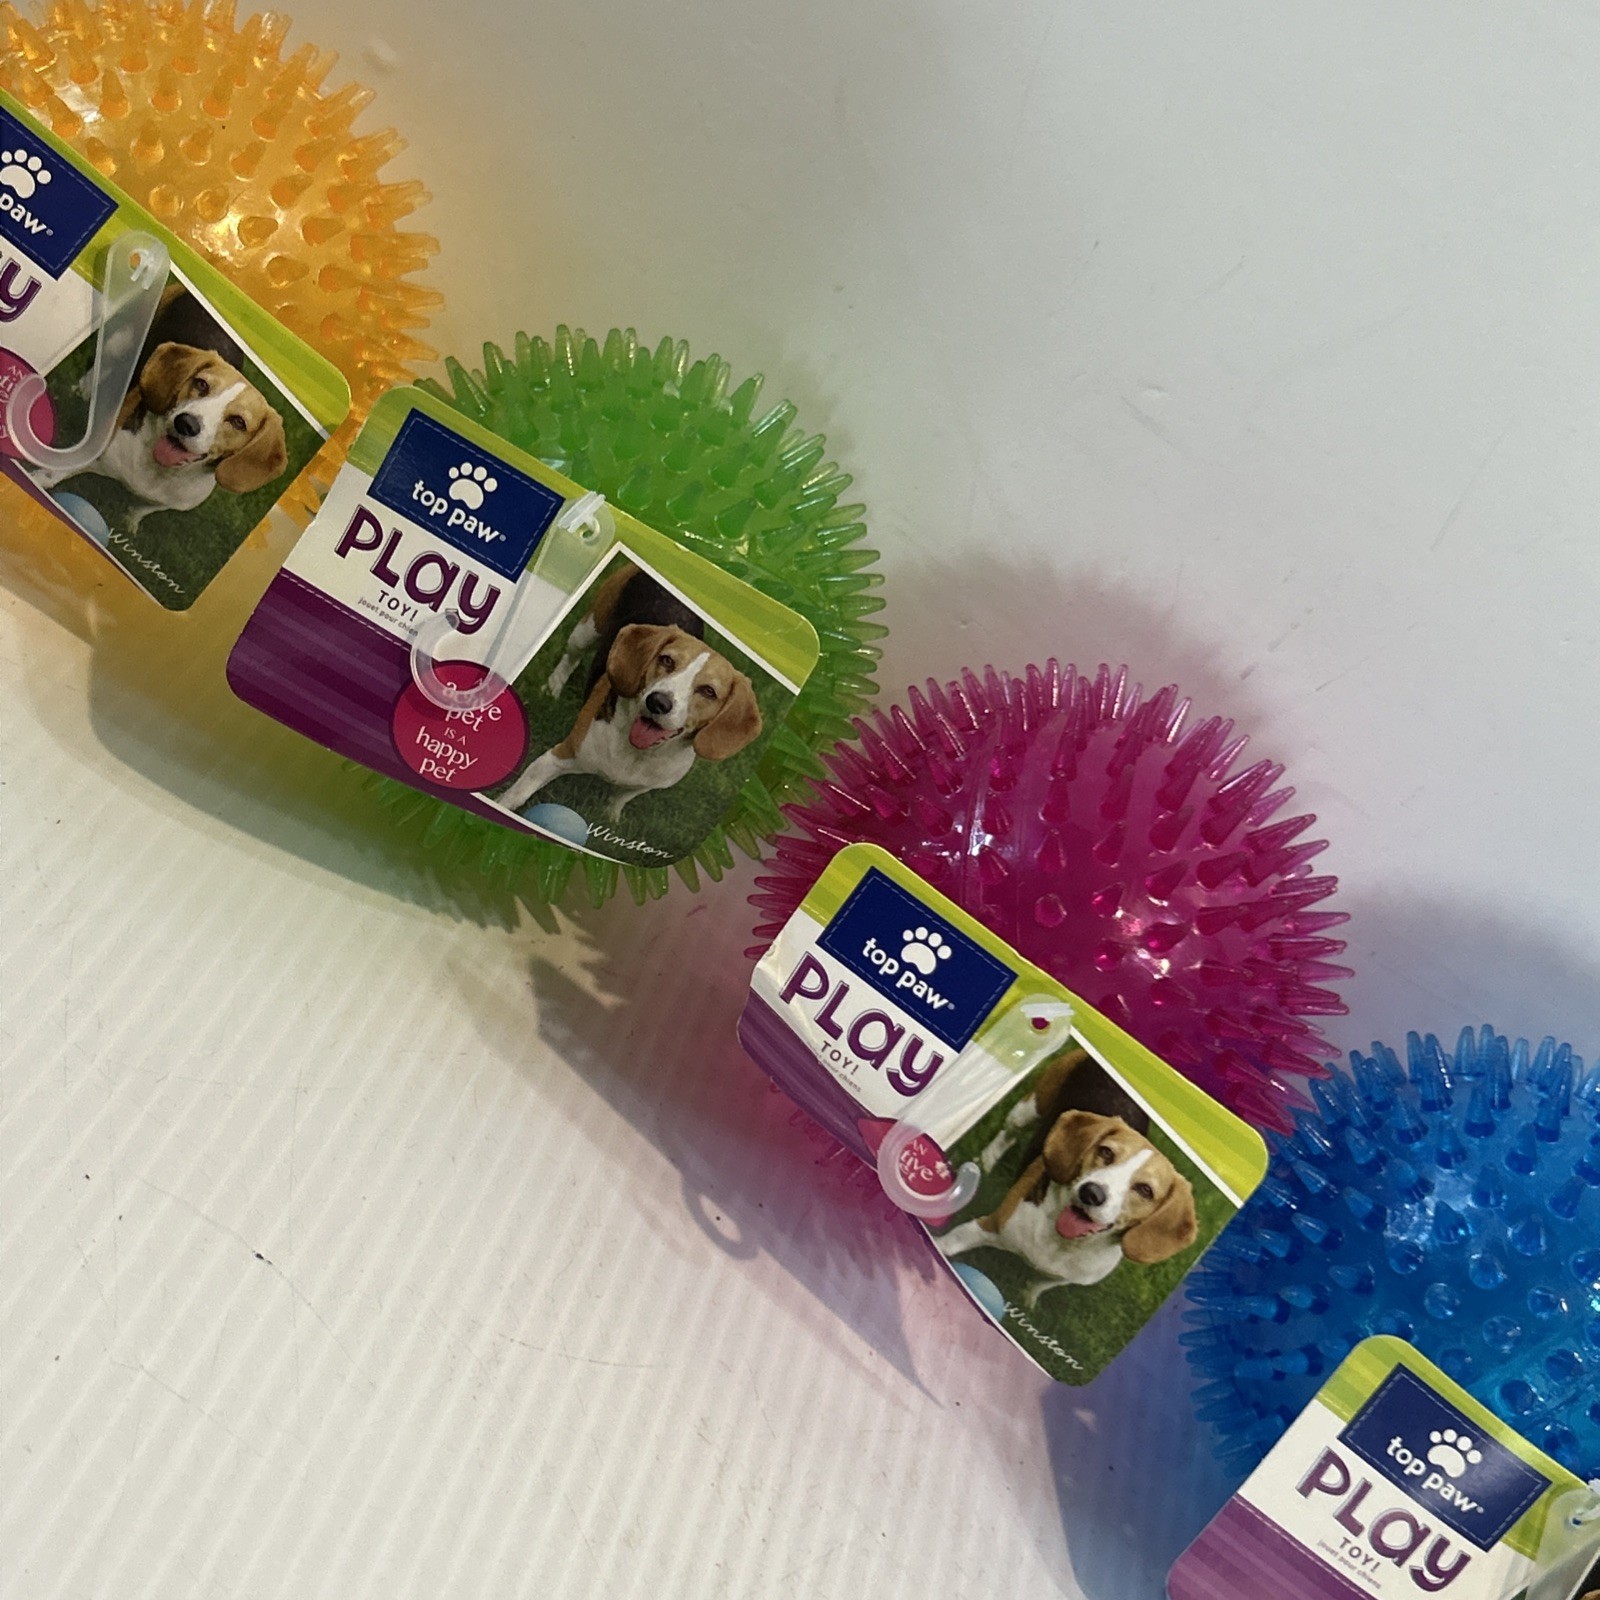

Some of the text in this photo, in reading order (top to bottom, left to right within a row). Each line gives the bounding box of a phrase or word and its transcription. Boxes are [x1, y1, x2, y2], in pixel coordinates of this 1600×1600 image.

[411, 479, 449, 517] top
[108, 527, 186, 594] Winston
[378, 589, 419, 622] TOY!
[443, 727, 457, 740] IS
[445, 707, 484, 732] pet
[415, 726, 479, 770] happy
[419, 757, 457, 783] pet
[586, 822, 674, 860] Winston
[862, 937, 900, 976] top
[821, 1040, 860, 1075] TOY!
[900, 1149, 934, 1182] tive
[1003, 1301, 1084, 1371] Winston
[1386, 1436, 1427, 1478] top
[1339, 1536, 1381, 1573] TOY!
